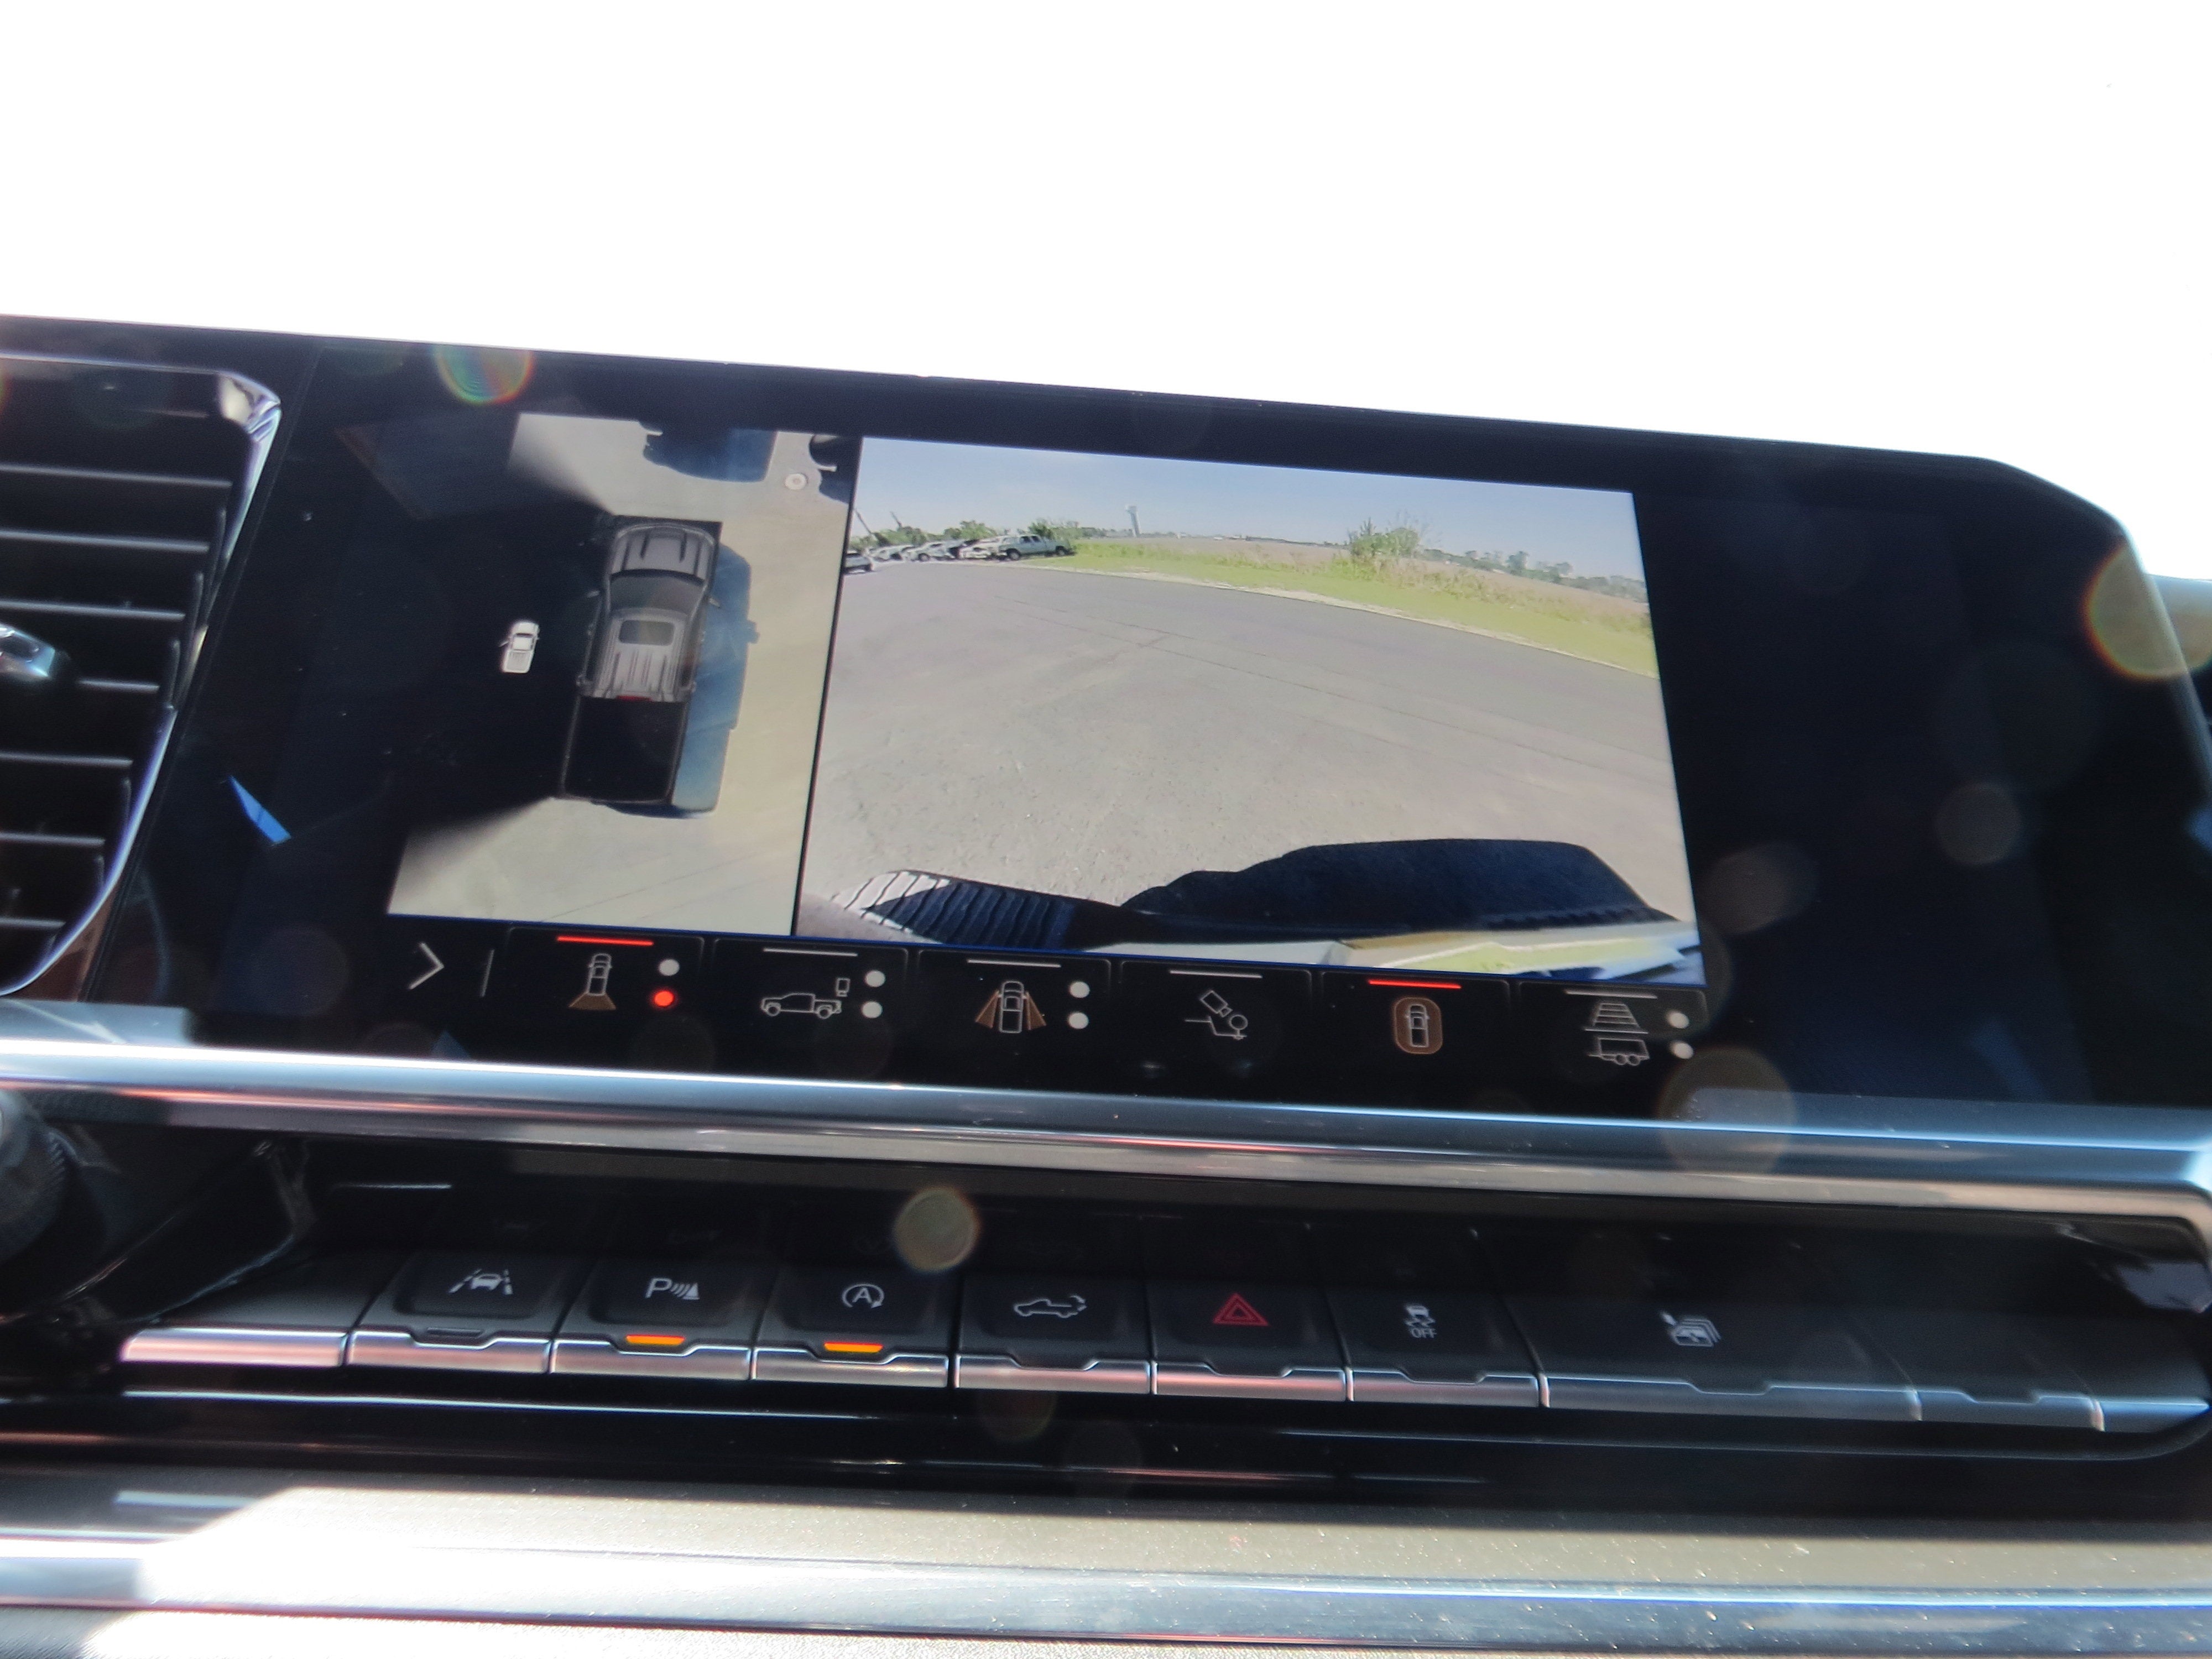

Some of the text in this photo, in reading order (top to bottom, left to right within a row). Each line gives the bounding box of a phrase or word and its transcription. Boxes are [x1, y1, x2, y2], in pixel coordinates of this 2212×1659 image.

[645, 1277, 672, 1298] P
[852, 1287, 872, 1303] A
[1411, 1328, 1437, 1338] OFF
